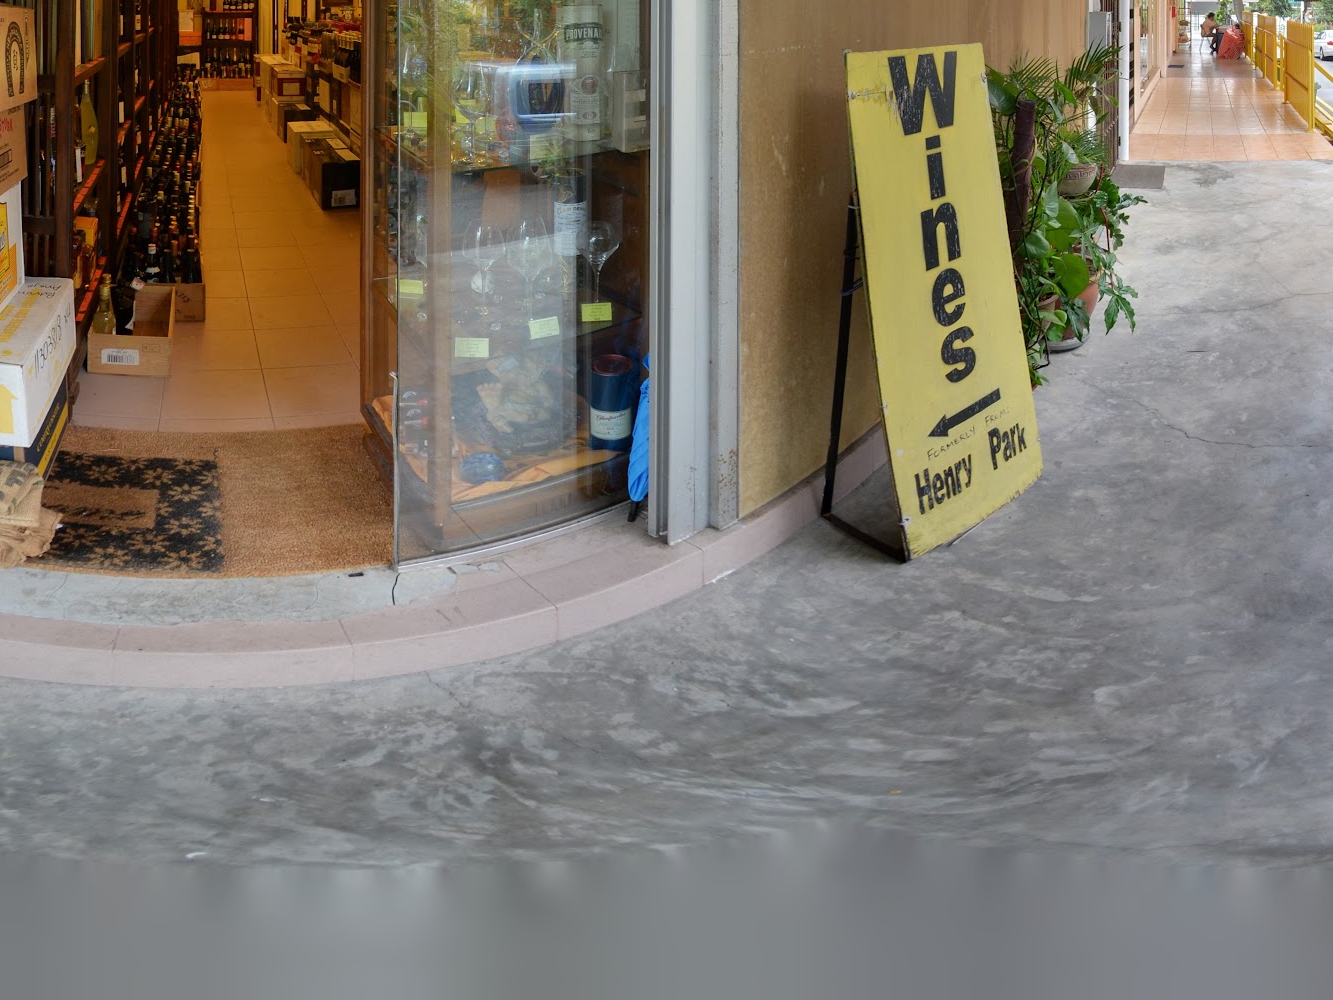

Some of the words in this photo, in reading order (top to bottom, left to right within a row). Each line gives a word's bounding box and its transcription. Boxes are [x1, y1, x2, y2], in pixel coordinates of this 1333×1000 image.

[888, 51, 976, 383] Wines
[914, 453, 972, 515] Henry
[988, 423, 1027, 471] Park
[927, 425, 975, 461] FORMERLY
